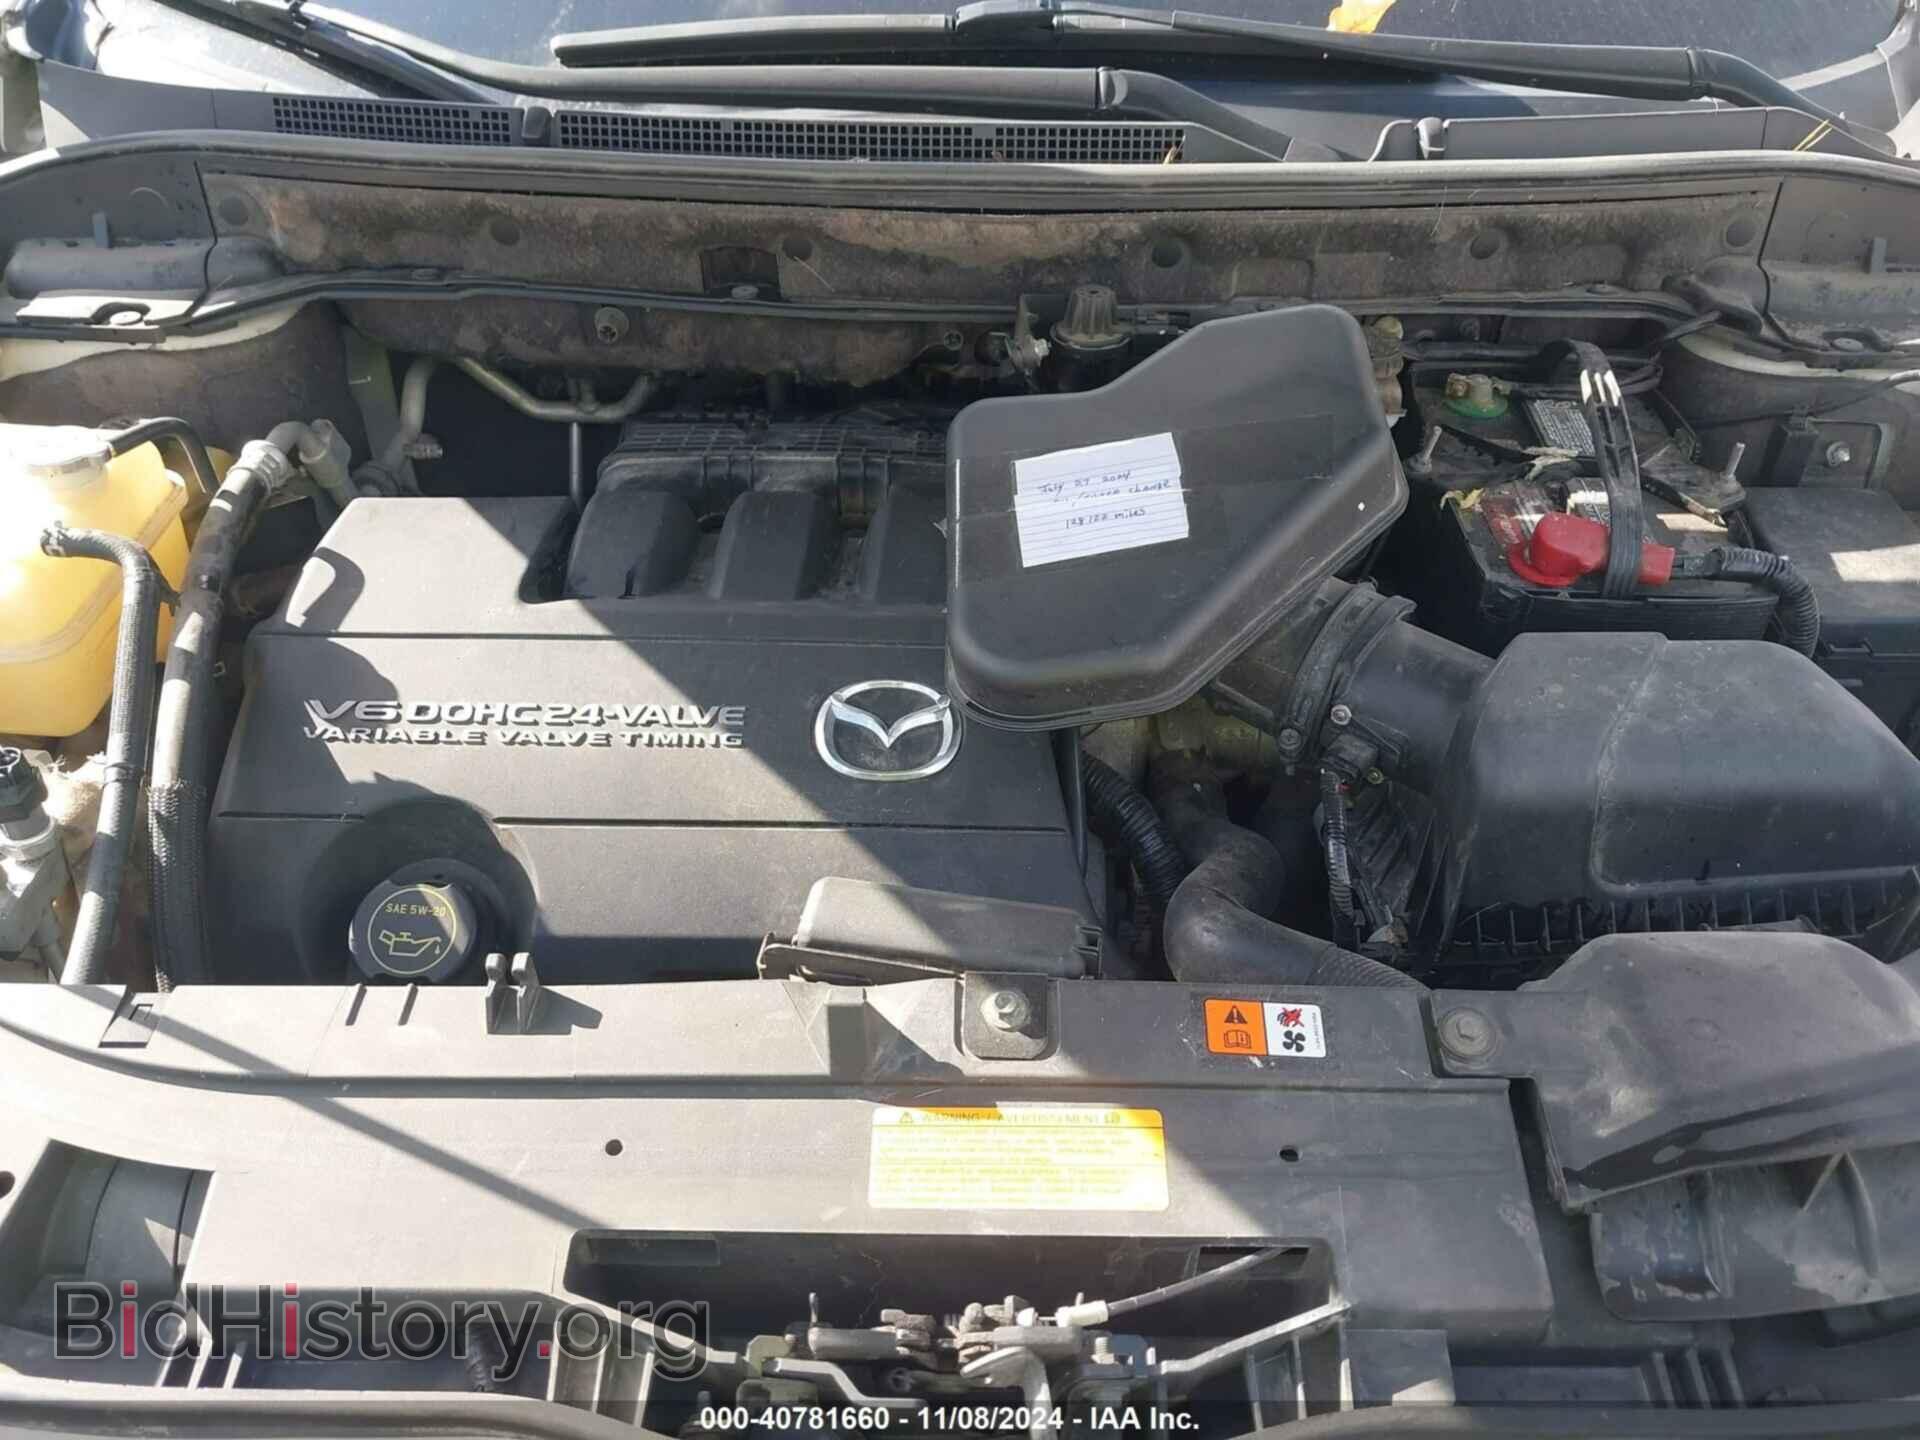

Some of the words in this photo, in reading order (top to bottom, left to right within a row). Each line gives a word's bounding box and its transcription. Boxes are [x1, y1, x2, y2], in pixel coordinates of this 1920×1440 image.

[304, 700, 400, 721] V6
[405, 701, 540, 726] DOHC
[543, 704, 746, 728] 24-VALVE
[303, 726, 488, 747] VARIABLE
[498, 729, 614, 747] VALVE
[622, 731, 745, 749] TIMING
[386, 903, 408, 914] SAE
[410, 904, 447, 917] 5W-20
